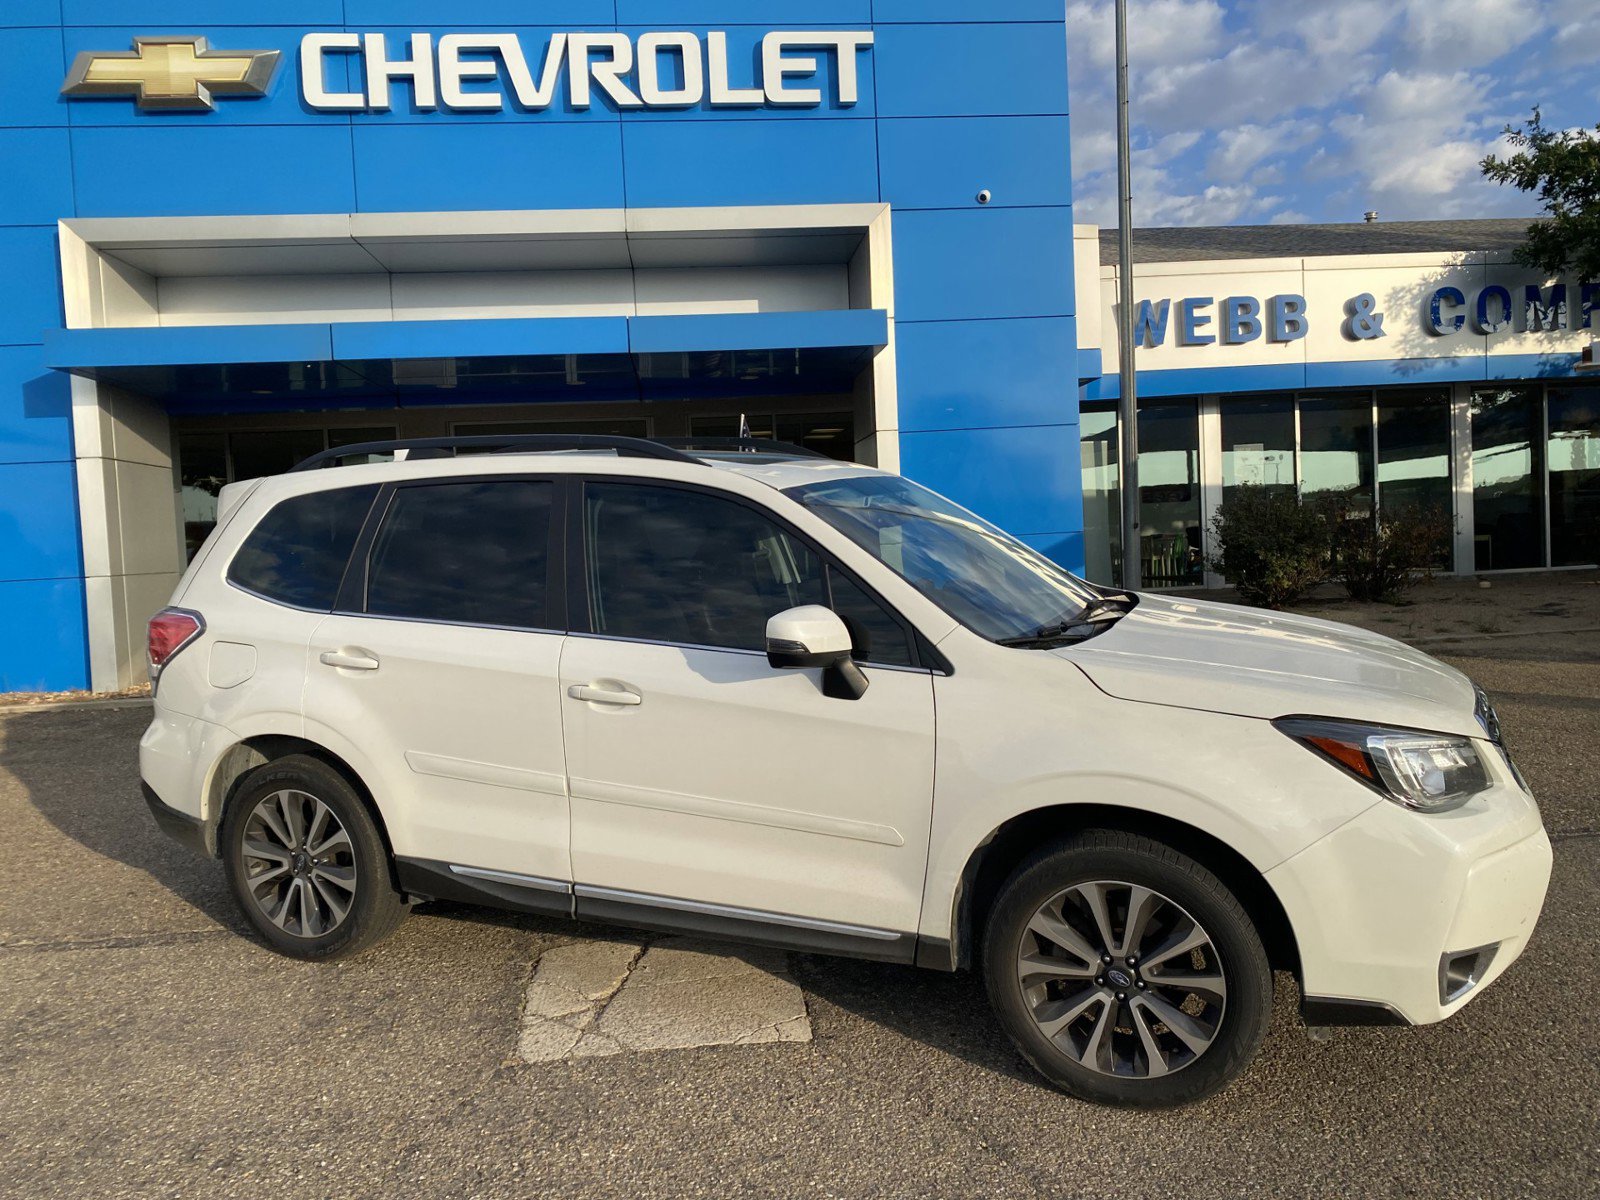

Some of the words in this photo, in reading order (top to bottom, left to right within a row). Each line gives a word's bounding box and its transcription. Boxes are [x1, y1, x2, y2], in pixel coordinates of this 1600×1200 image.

[301, 31, 874, 111] CHEVROLET
[1129, 294, 1309, 347] WEBB
[1349, 293, 1387, 341] &
